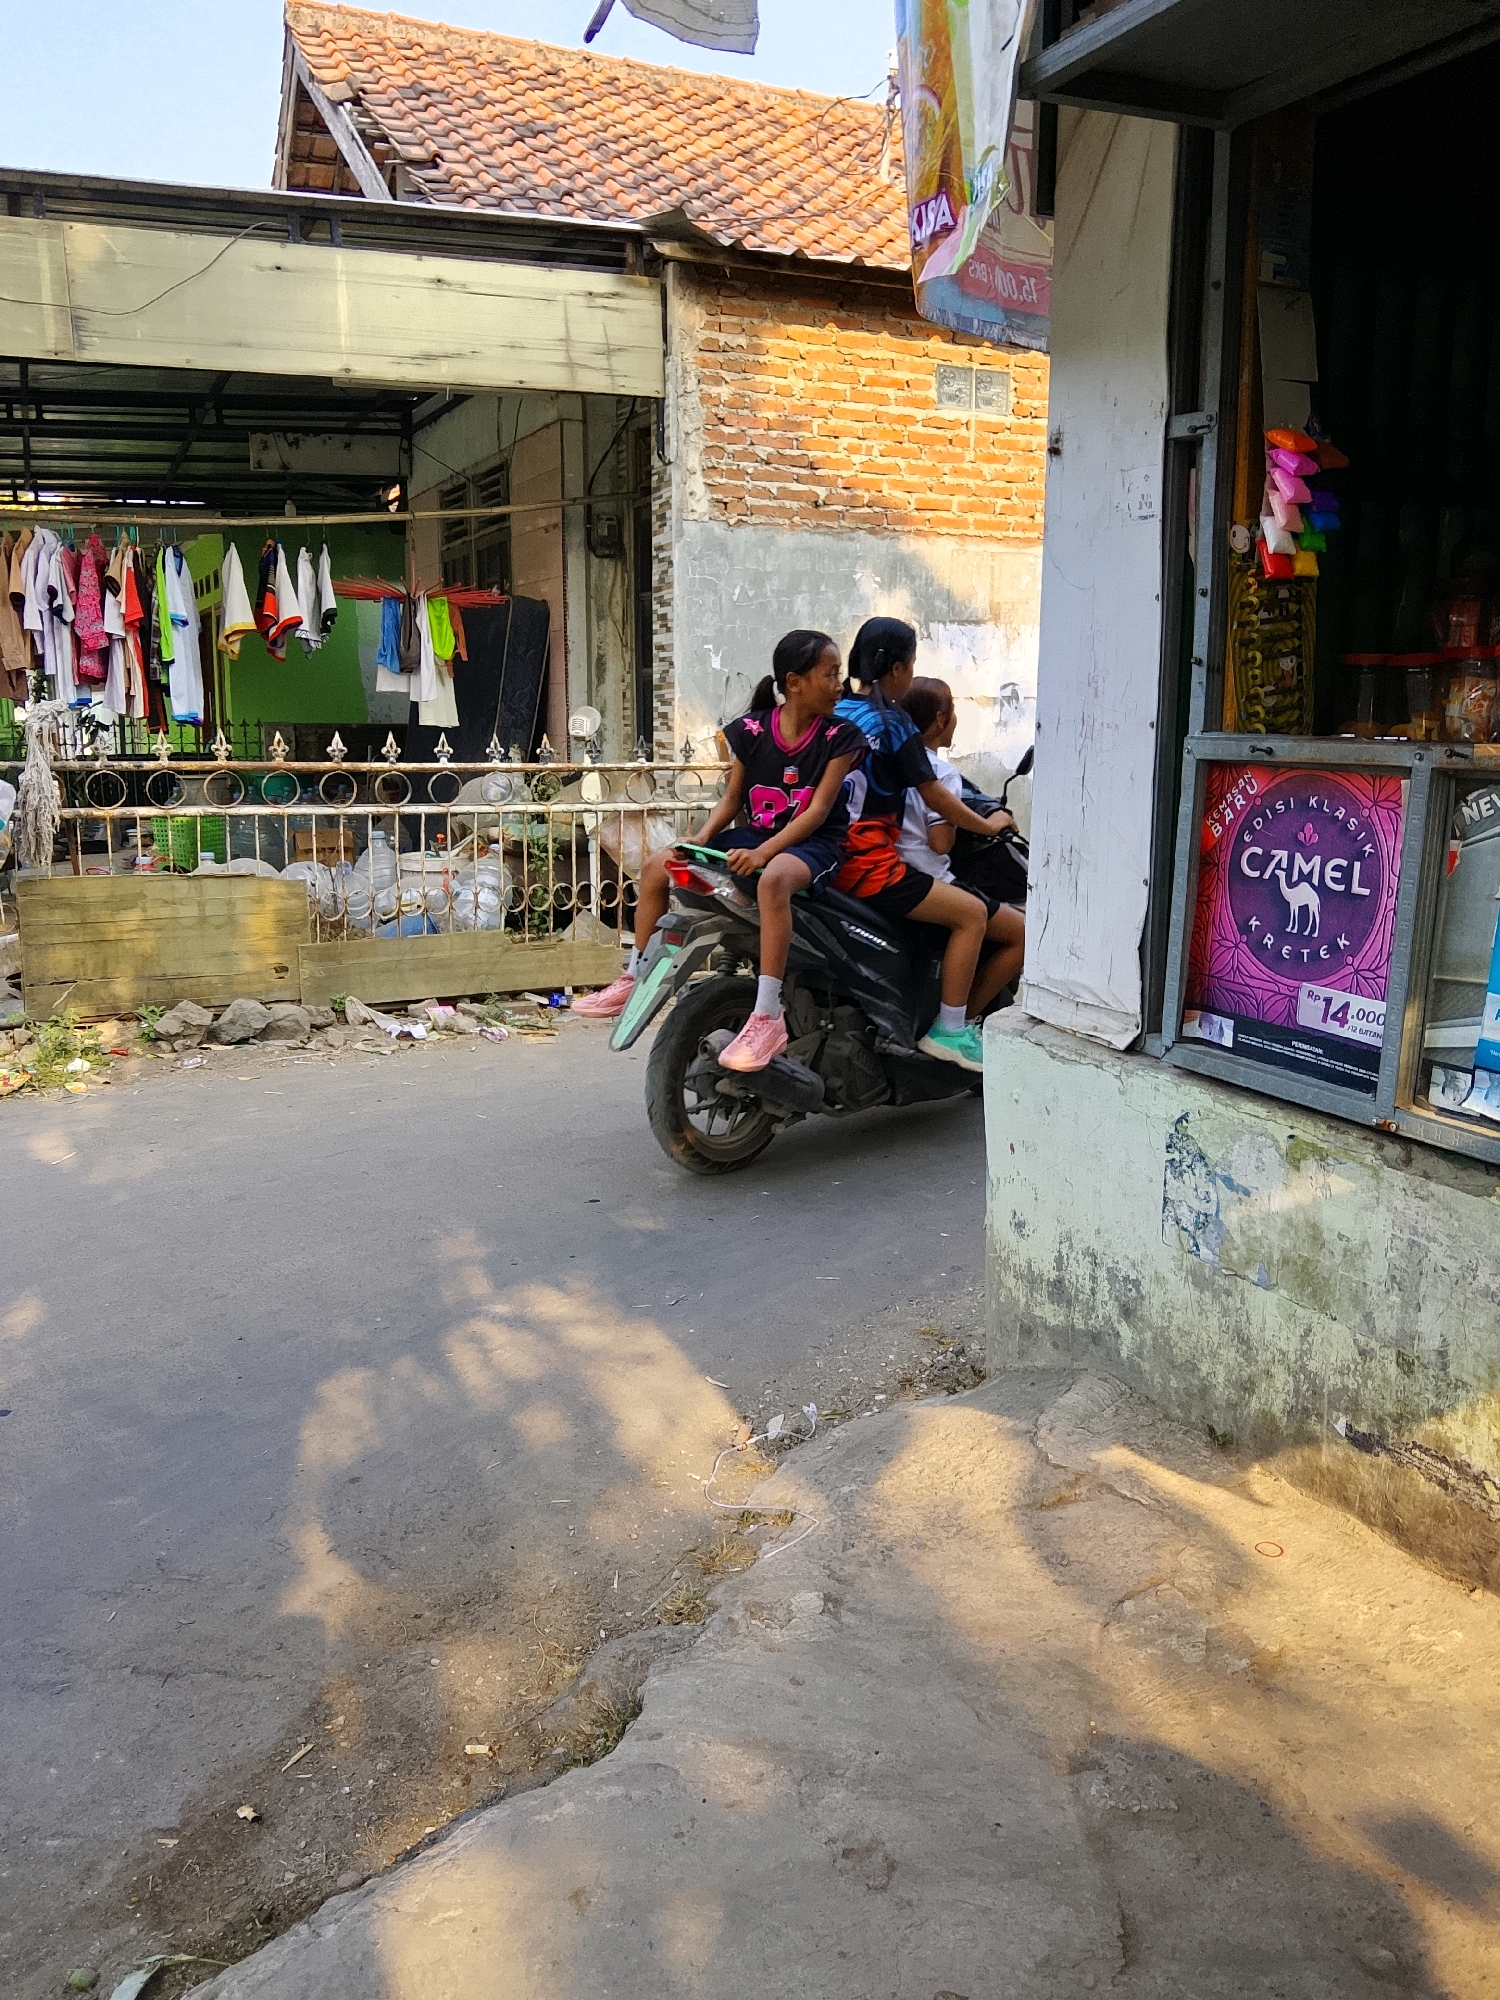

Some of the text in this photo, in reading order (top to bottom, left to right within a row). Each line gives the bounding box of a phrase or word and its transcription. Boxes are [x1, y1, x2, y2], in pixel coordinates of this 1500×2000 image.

[1205, 770, 1252, 827] KEMASAN
[1211, 778, 1258, 838] BARU
[1243, 795, 1375, 858] EDISI KLASIK
[1240, 846, 1371, 896] CAMEL
[1248, 915, 1350, 963] KRETEK
